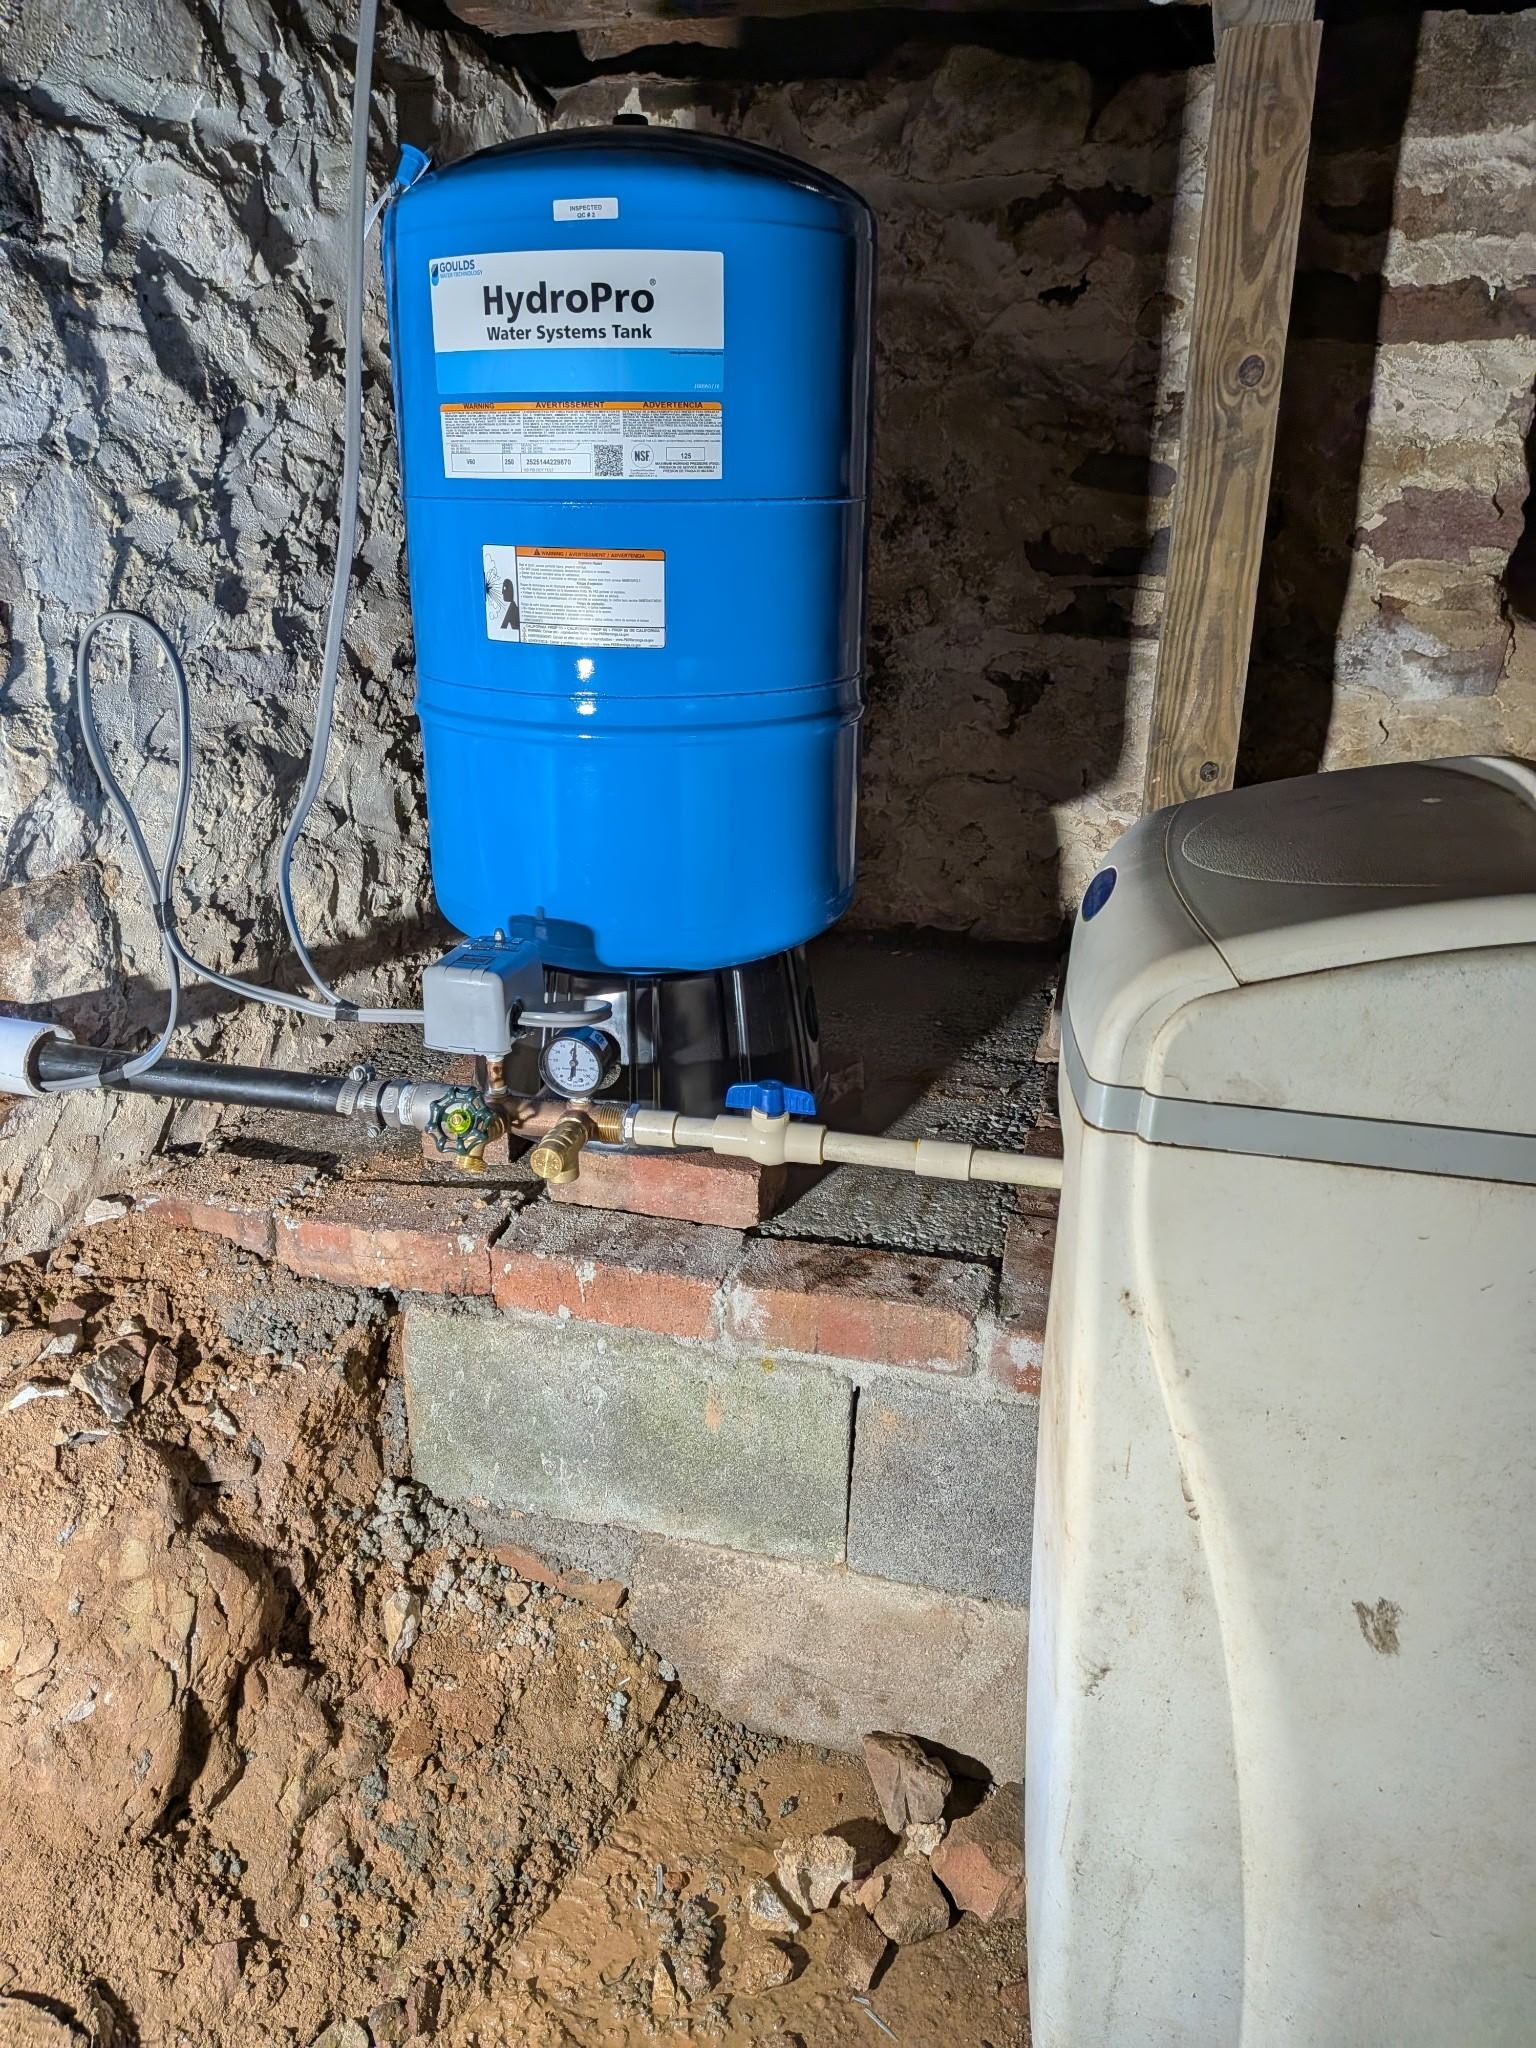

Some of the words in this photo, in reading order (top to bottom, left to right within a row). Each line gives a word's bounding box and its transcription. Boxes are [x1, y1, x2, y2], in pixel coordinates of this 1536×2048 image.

[569, 204, 603, 212] INSPECTED
[439, 259, 476, 273] GOULDS
[453, 270, 483, 278] TECHNOLOGY
[487, 326, 532, 342] Water
[536, 324, 607, 343] Systems
[612, 323, 653, 339] Tank
[634, 450, 650, 462] NSF
[680, 452, 692, 460] 125
